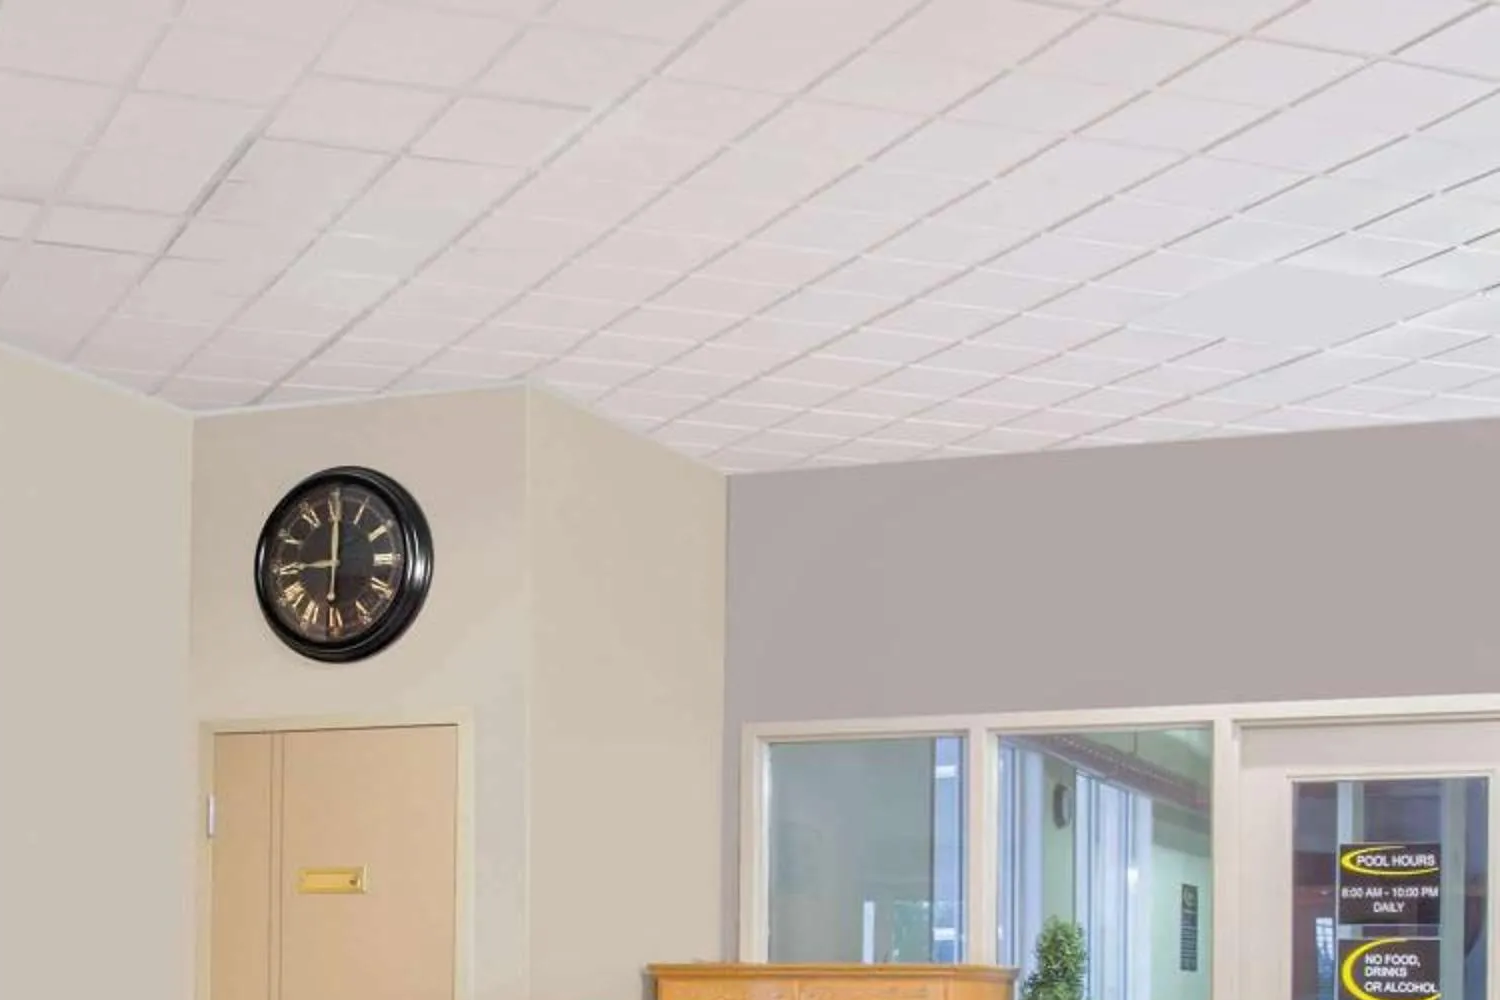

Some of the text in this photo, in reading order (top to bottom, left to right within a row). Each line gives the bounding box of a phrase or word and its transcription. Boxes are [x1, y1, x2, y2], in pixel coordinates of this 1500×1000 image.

[1356, 854, 1435, 867] POOL HOURS
[1366, 887, 1383, 897] AM
[1392, 887, 1419, 897] 10:00
[1421, 887, 1439, 897] PM
[1373, 901, 1405, 913] DAILY
[1364, 954, 1421, 968] NO FOOD,
[1364, 966, 1408, 977] DRINKS
[1364, 982, 1438, 993] OR ALCOHOL
